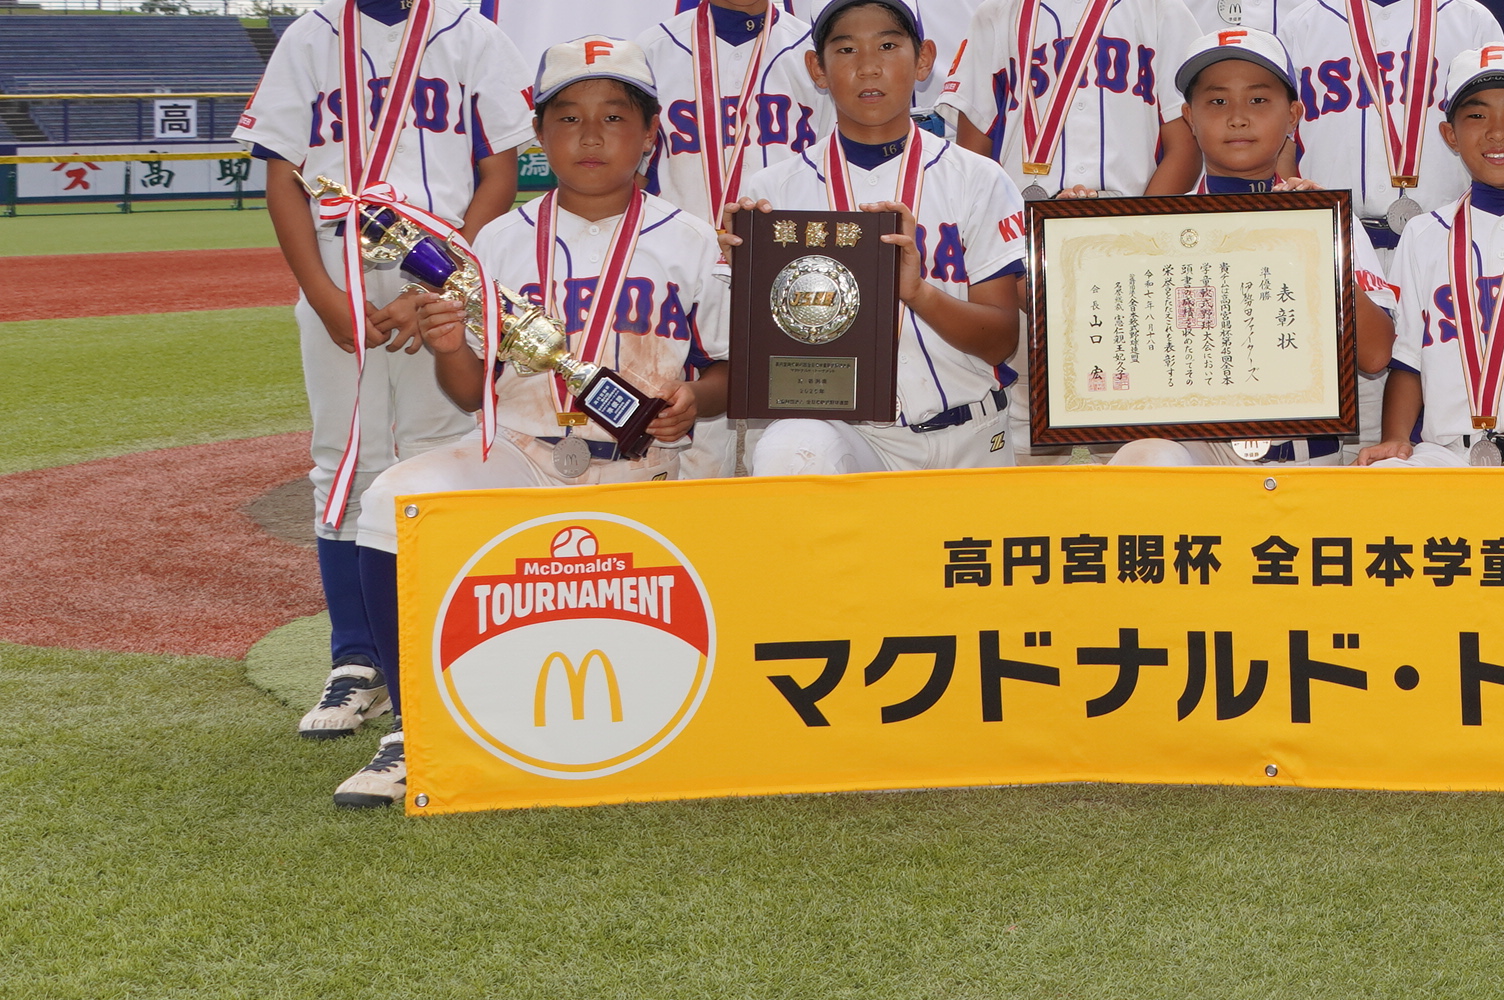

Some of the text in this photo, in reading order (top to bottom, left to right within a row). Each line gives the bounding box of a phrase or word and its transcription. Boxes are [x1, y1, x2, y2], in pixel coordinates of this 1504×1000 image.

[746, 19, 755, 32] 9
[1217, 30, 1248, 46] F
[585, 40, 614, 65] F
[159, 103, 192, 134] 高
[882, 144, 897, 158] 16
[1259, 266, 1272, 301] 準優勝
[1275, 283, 1299, 350] 表彰状
[523, 557, 626, 576] McDonald's
[943, 533, 1222, 588] 高円宮賜杯
[473, 575, 675, 635] TOURNAMENT
